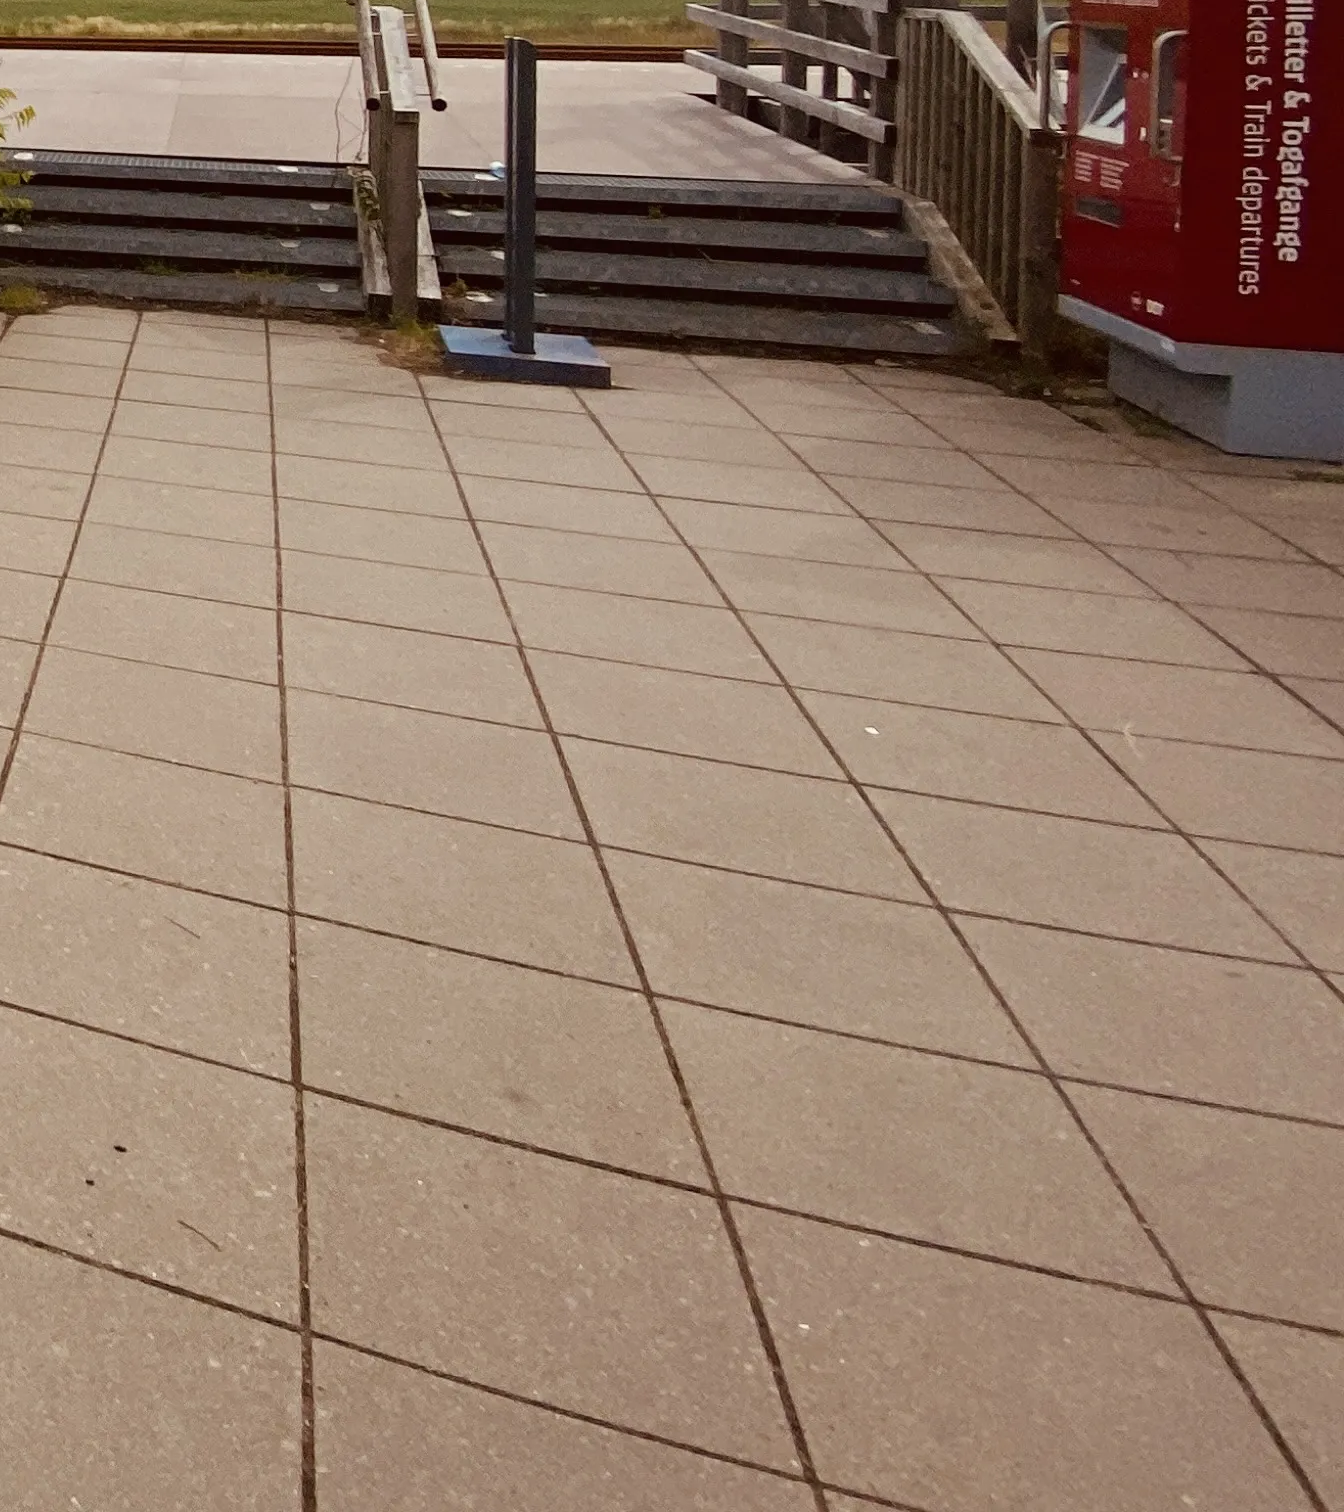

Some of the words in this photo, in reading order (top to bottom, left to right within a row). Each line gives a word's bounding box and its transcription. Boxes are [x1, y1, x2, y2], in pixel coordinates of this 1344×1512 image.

[1245, 74, 1273, 91] &
[1283, 90, 1311, 109] &
[1243, 100, 1272, 157] Train
[1272, 116, 1310, 262] Togafgange
[1235, 166, 1270, 295] departures
